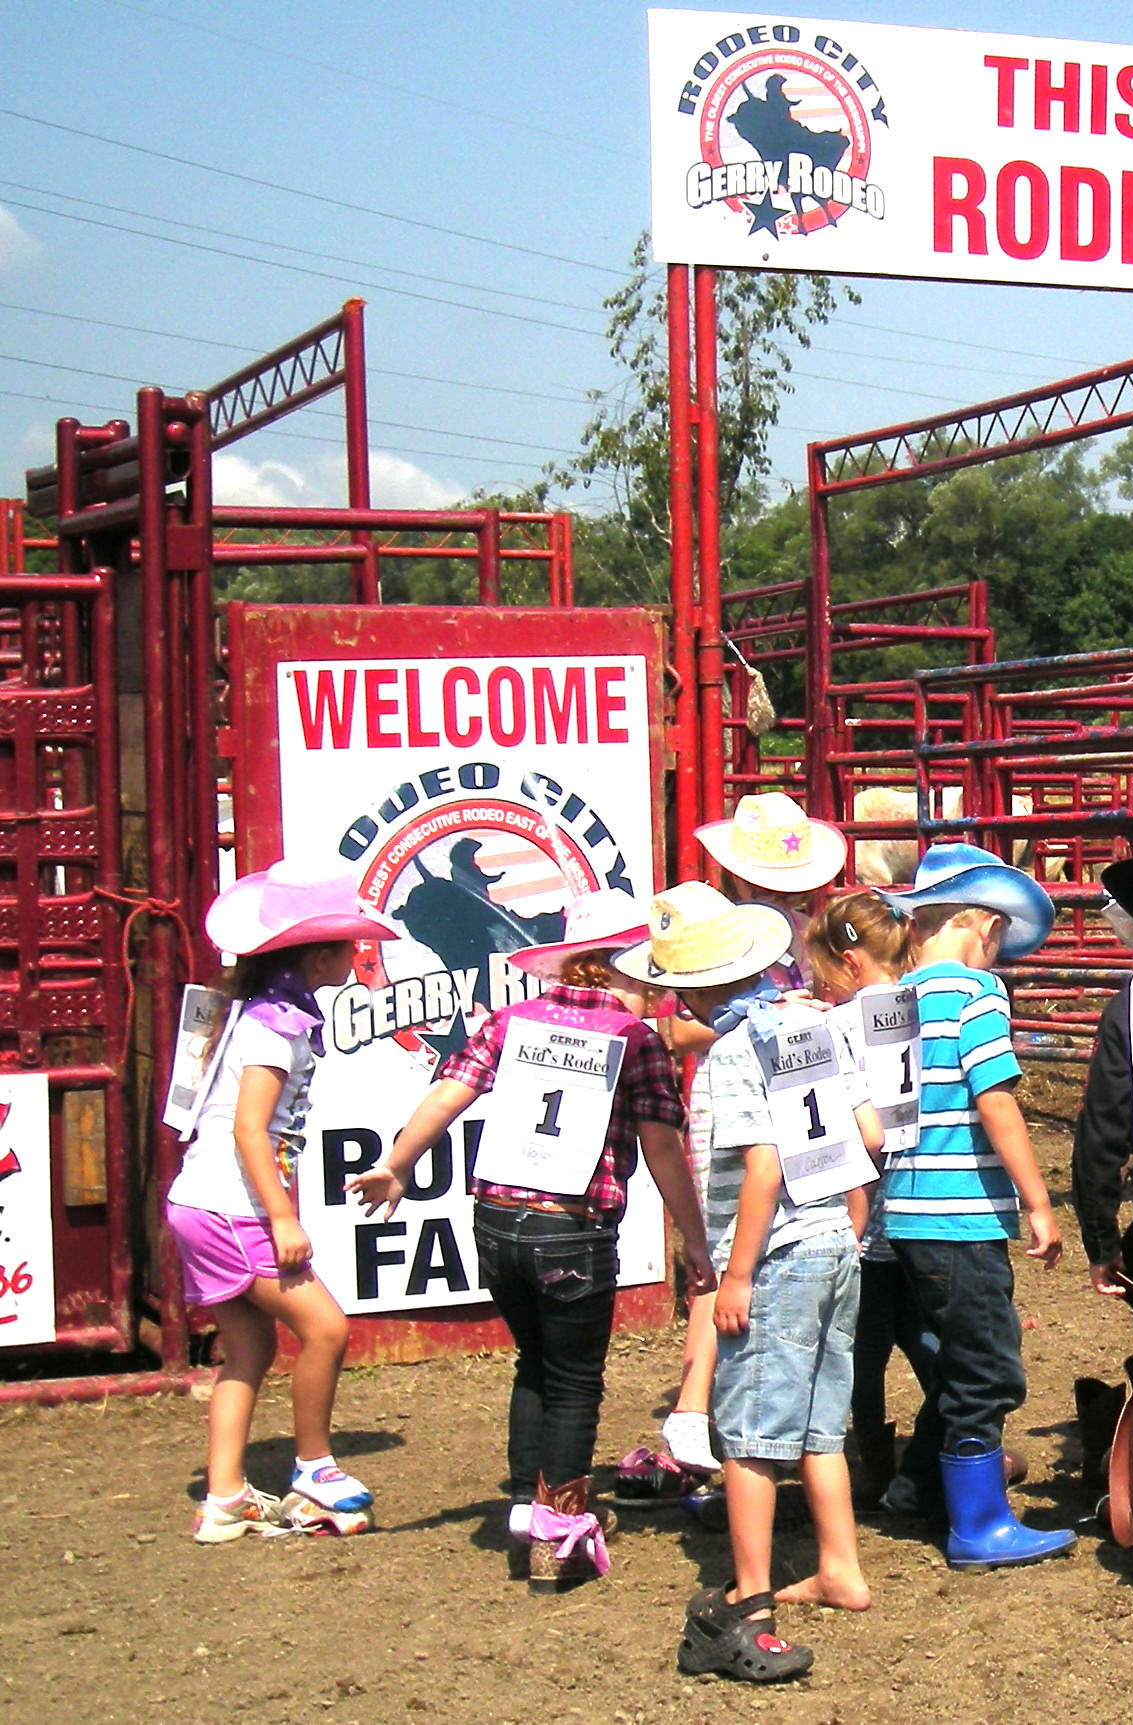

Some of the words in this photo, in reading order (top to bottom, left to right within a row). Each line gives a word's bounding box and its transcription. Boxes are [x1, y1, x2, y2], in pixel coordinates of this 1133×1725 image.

[678, 24, 800, 115] RODEO
[814, 34, 889, 128] CITY
[705, 121, 715, 142] THE
[775, 54, 803, 66] RODEO
[804, 59, 825, 75] EAST
[823, 69, 836, 82] OF
[686, 159, 783, 208] GERRY
[788, 153, 885, 220] RODEO
[293, 665, 629, 750] WELCOME
[338, 762, 500, 862] ODEO
[520, 771, 635, 898] CITY
[367, 861, 393, 906] LDEST
[387, 810, 462, 865] CONSECUTIVE
[462, 808, 504, 822] RODEO
[506, 812, 536, 832] EAST
[535, 823, 551, 841] OF
[332, 967, 479, 1055] GERRY
[549, 1034, 588, 1048] GERRY
[518, 1044, 558, 1065] Kid's
[562, 1053, 610, 1074] Rodeo
[770, 1050, 802, 1073] Kid's
[805, 1046, 832, 1065] Rodeo
[900, 1045, 913, 1094] 1
[535, 1089, 564, 1137] 1
[803, 1088, 826, 1140] 1
